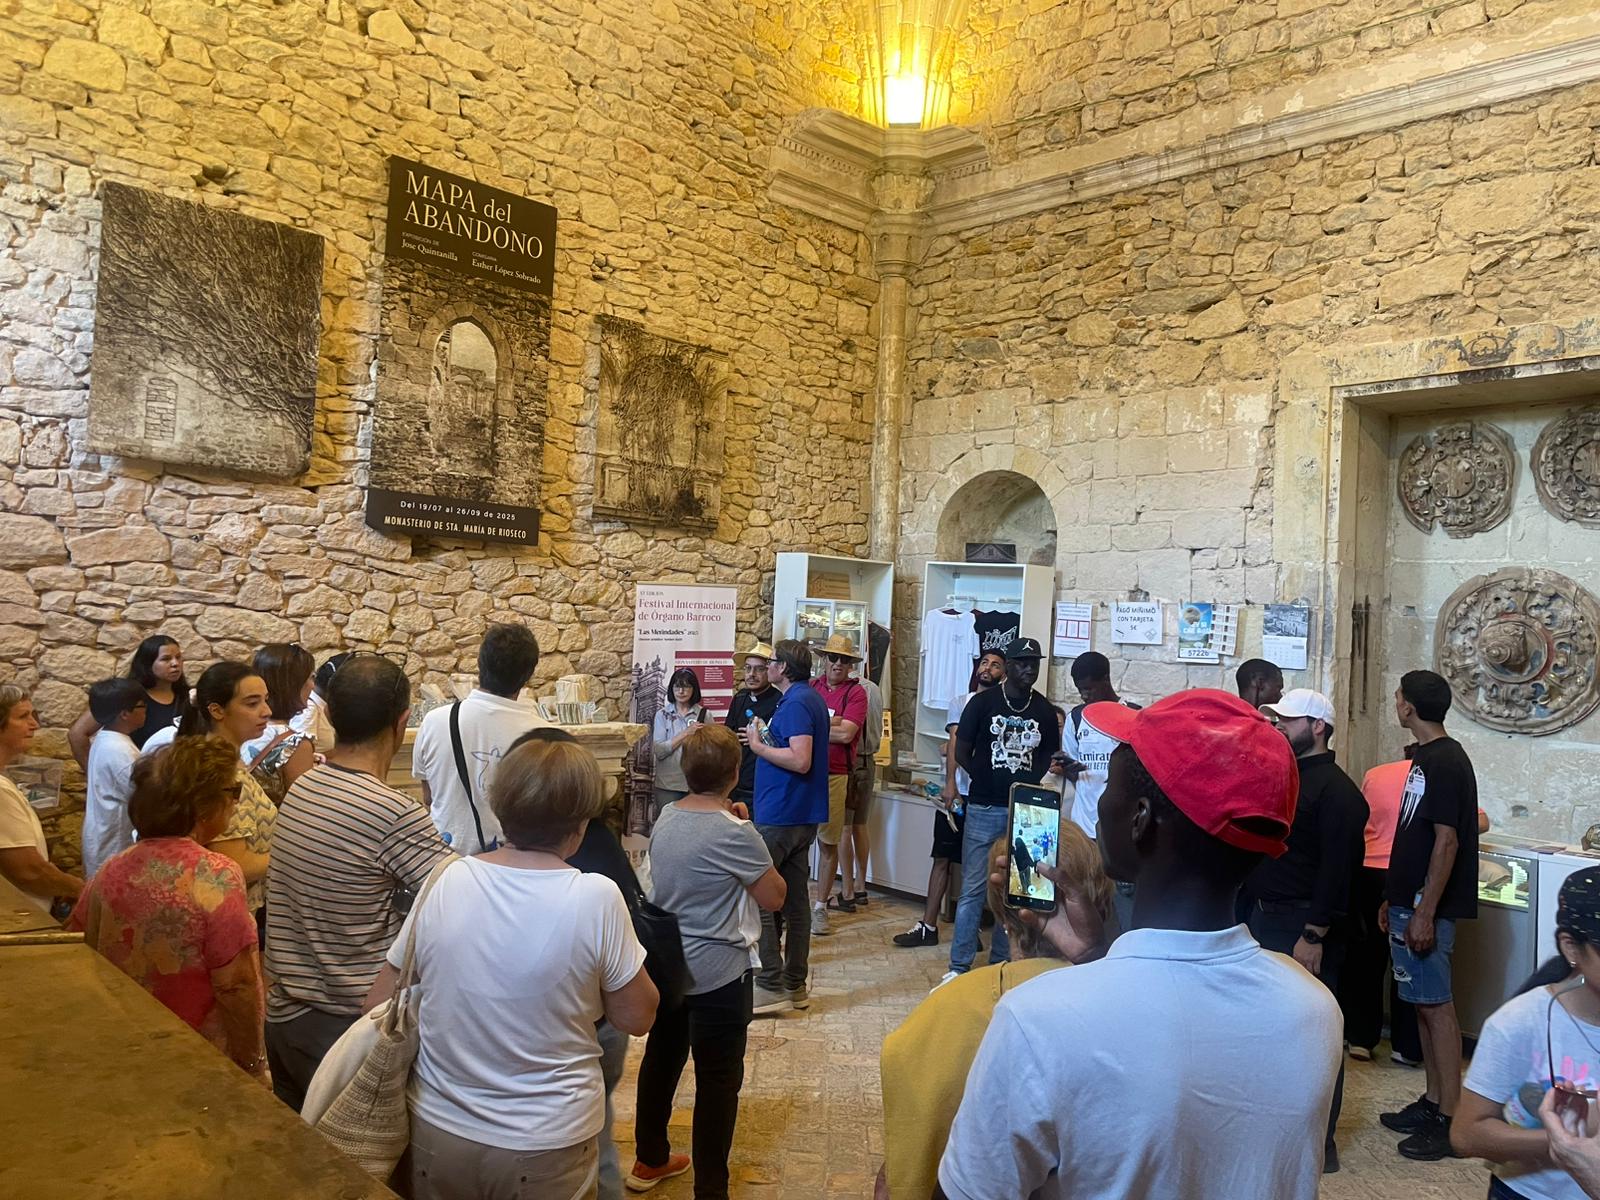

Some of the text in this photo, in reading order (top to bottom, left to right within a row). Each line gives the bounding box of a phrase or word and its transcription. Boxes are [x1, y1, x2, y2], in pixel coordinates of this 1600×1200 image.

[406, 169, 511, 224] MAPA del
[403, 200, 543, 259] ABANDONO
[417, 243, 458, 262] Quintanilla
[472, 258, 541, 284] Esther López Sobrado
[400, 500, 517, 522] Del 19/07 al 26/09 de 2025
[384, 515, 527, 540] MONASTERIO DE STA. MARÍA DE RIOSECO
[638, 598, 734, 611] Festival Internacional
[638, 610, 721, 623] de Órgano Barroco
[1130, 616, 1154, 624] TARJETA
